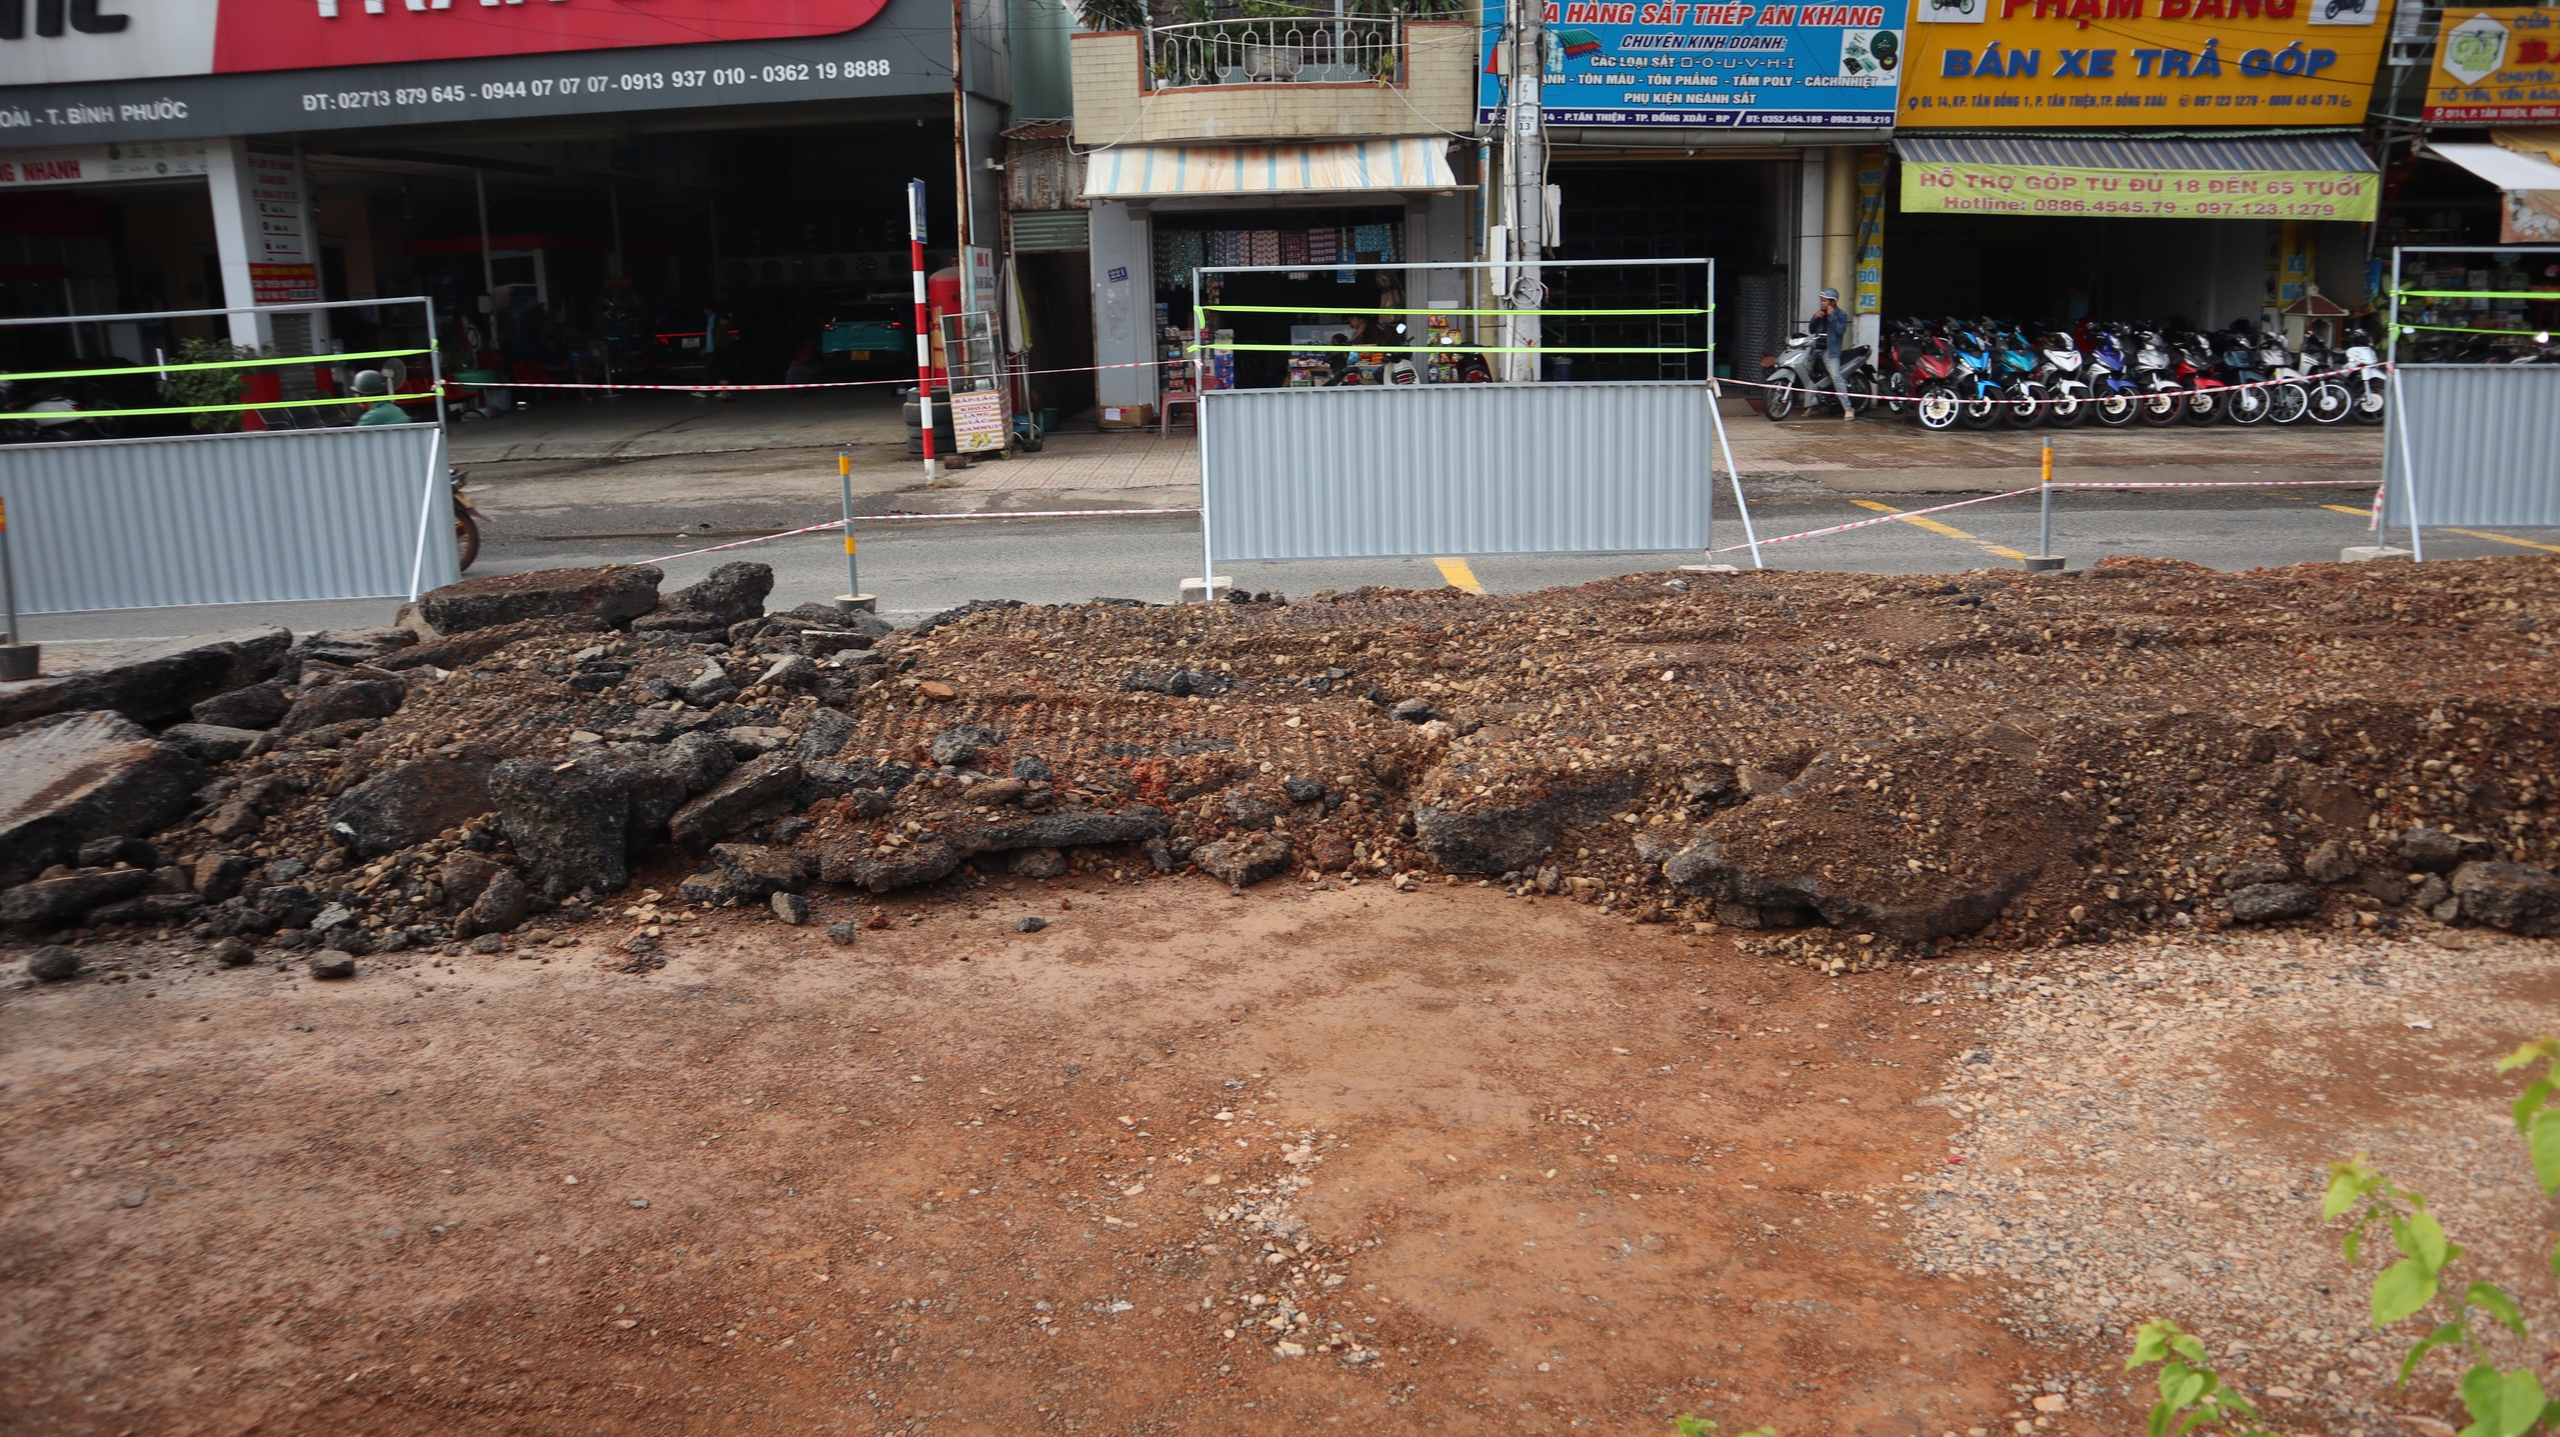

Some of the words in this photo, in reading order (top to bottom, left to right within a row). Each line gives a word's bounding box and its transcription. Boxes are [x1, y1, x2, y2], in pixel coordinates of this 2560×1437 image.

[1566, 0, 1634, 24] HÀNG
[1640, 0, 1689, 25] SẮT
[1692, 1, 1755, 26] THÉP
[1757, 4, 1797, 26] AN
[1798, 5, 1886, 27] KHANG
[1621, 32, 1685, 49] CHUYÊN
[1686, 35, 1727, 49] KINH
[1728, 35, 1788, 50] DOANH:
[1590, 54, 1617, 67] CÁC
[1619, 56, 1649, 69] LOẠI
[1651, 54, 1676, 68] SẮT
[1940, 41, 2041, 77] BÁN
[2052, 49, 2117, 77] XE
[2131, 37, 2222, 77] TRẢ
[2238, 41, 2338, 77] GÓP
[396, 88, 428, 105] 879
[431, 85, 466, 102] 645
[481, 81, 527, 99] 0944
[531, 79, 554, 96] 07
[559, 77, 581, 94] 07
[671, 70, 706, 87] 937
[713, 67, 746, 85] 010
[762, 64, 810, 82] 0362
[815, 62, 838, 80] 19
[843, 59, 890, 78] 8888
[1578, 72, 1604, 85] TÔN
[1606, 72, 1635, 85] MÀU
[1646, 73, 1672, 86] TÔN
[1732, 73, 1760, 87] TẤM
[1762, 76, 1794, 87] POLY
[1804, 74, 1838, 87] CÁCH
[1839, 75, 1878, 89] NHIỆT
[1623, 93, 1650, 106] PHỤ
[1652, 92, 1683, 106] KIỆN
[1685, 92, 1730, 104] NGÀNH
[1732, 91, 1757, 104] SẮT
[1595, 111, 1625, 123] THIỆN
[1635, 113, 1650, 122] TP.
[1682, 113, 1707, 123] XOÀI
[1716, 114, 1730, 123] BP
[1519, 122, 1531, 131] 13
[22, 160, 82, 182] NHANH
[1920, 167, 1956, 188] HỖ
[1964, 174, 2017, 193] TRỢ
[2025, 172, 2078, 191] GÓP
[2085, 174, 2122, 192] TỪ
[2128, 172, 2164, 193] ĐỦ
[2173, 179, 2200, 194] 18
[2208, 174, 2259, 195] ĐẾN
[2266, 180, 2295, 195] 65
[2303, 174, 2362, 197] TUỔI
[1944, 196, 2026, 211] Hotline:
[2034, 199, 2176, 215] 0886.4545.79
[2196, 202, 2335, 216] 097.123.1279
[1860, 293, 1876, 308] XE
[960, 404, 993, 413] KHOAI
[963, 411, 990, 419] LANG
